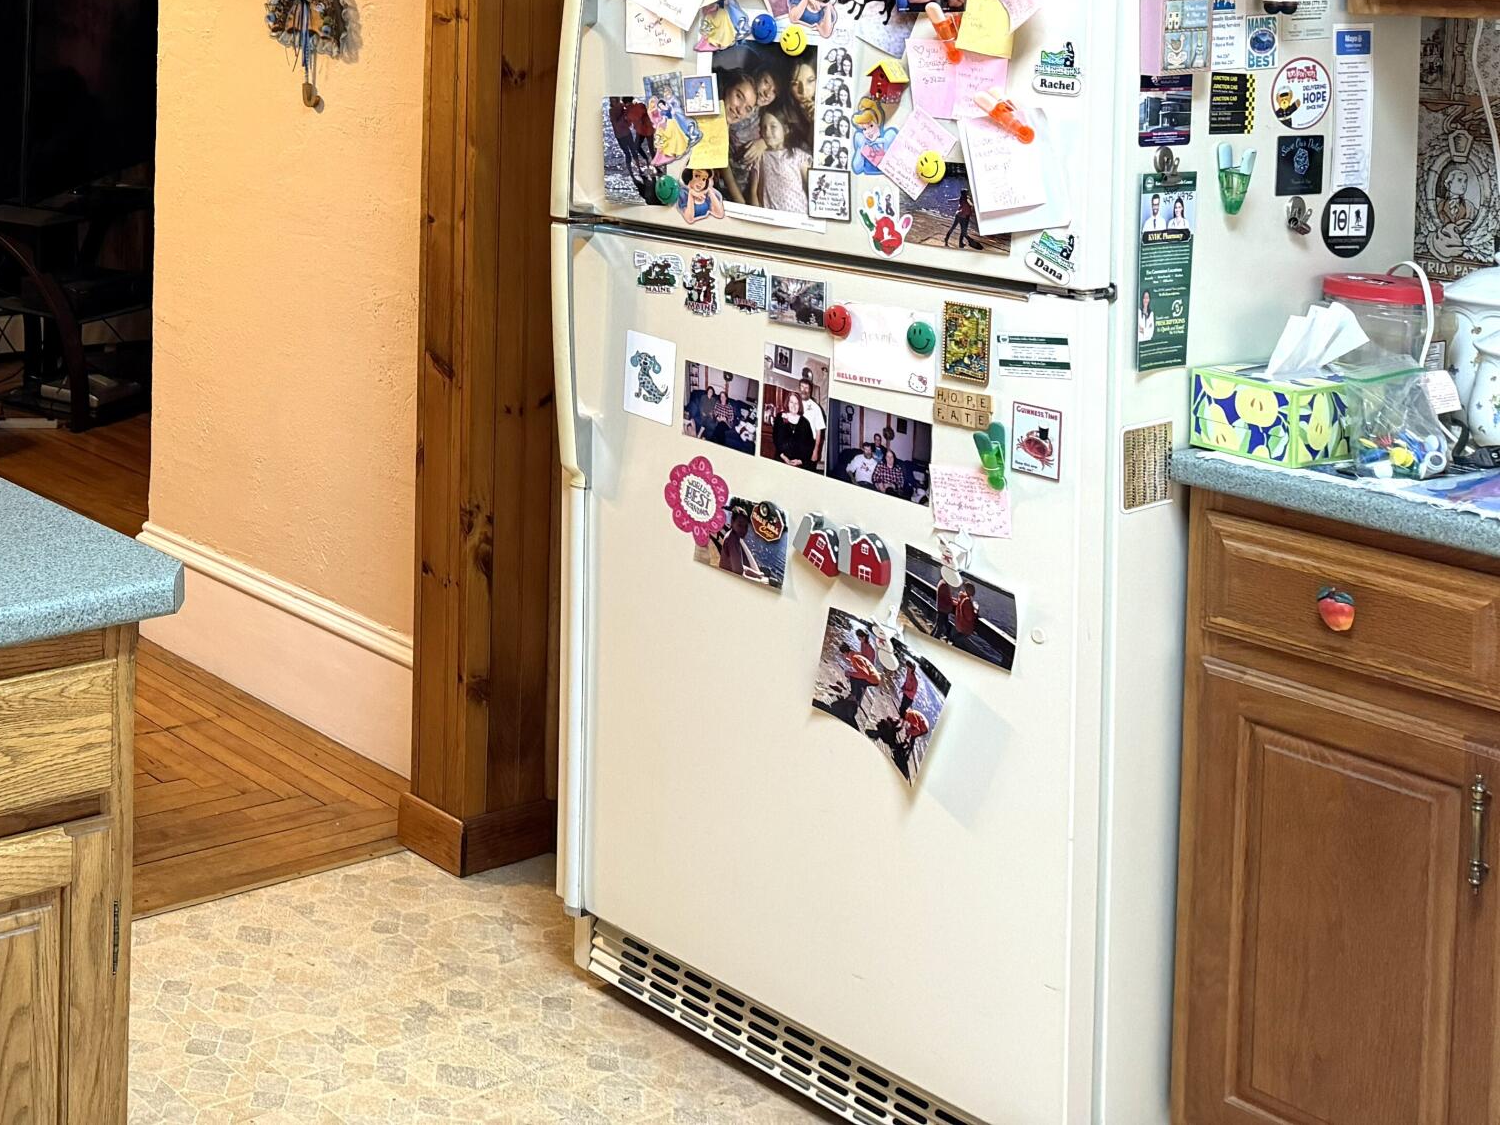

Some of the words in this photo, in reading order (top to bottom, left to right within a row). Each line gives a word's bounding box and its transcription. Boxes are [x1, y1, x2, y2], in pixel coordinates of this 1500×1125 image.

[1247, 50, 1277, 69] BEST
[1040, 78, 1075, 91] Rachel
[1303, 91, 1327, 104] HOPE
[1034, 257, 1063, 280] Dana
[1418, 260, 1448, 274] TRIA
[836, 371, 858, 382] HELLO
[859, 376, 882, 386] KITTY
[937, 390, 989, 408] HOPE
[937, 407, 987, 426] FATE
[1016, 405, 1045, 419] GUINNESS
[685, 485, 711, 510] BEST
